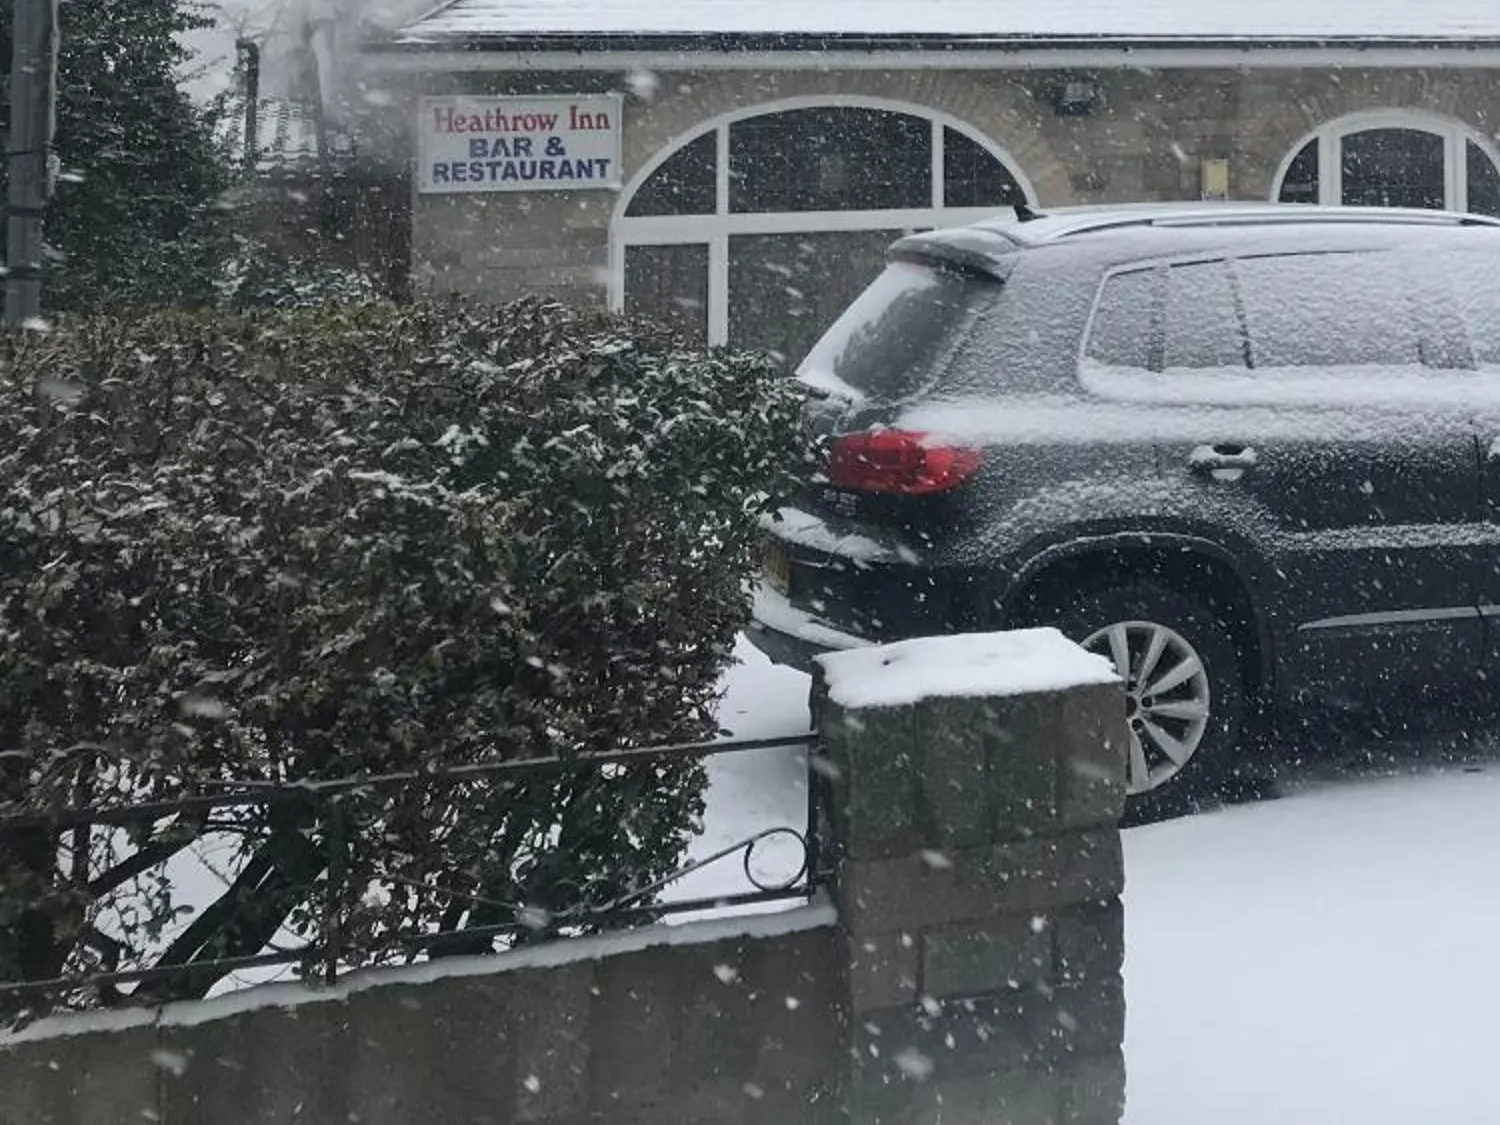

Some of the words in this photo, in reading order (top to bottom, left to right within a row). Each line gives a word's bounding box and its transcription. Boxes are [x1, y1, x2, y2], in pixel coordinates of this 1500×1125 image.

[433, 107, 559, 133] Heathrow
[569, 105, 610, 131] Inn
[469, 137, 533, 158] BAR
[544, 136, 566, 156] &
[432, 159, 611, 184] RESTAURANT
